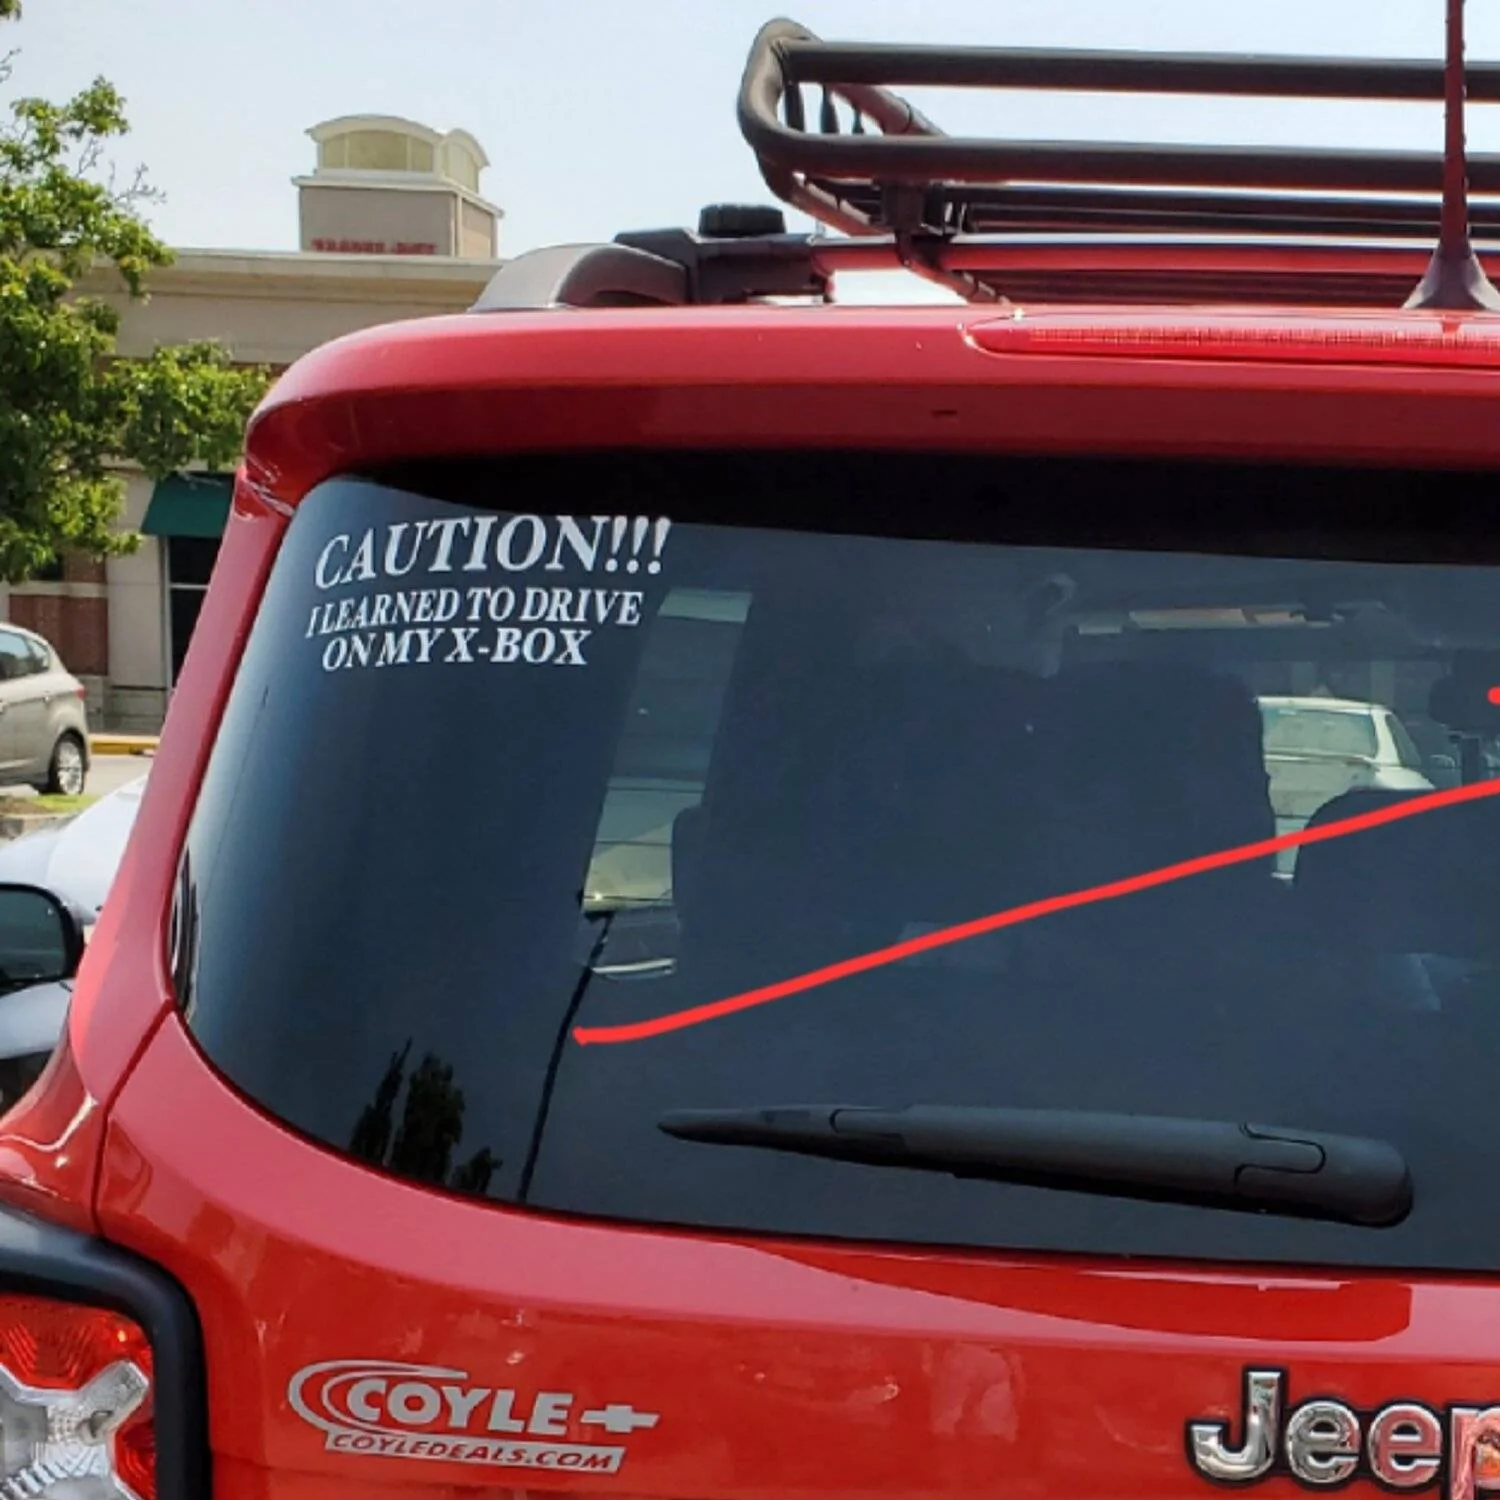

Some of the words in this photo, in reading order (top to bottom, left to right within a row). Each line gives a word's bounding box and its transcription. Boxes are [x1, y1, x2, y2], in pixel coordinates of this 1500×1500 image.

[315, 514, 672, 590] CAUTION!!!
[305, 606, 319, 639] I
[321, 589, 460, 634] LEARNED
[465, 587, 517, 623] TO
[519, 588, 643, 626] DRIVE
[322, 632, 379, 672] ON
[375, 629, 446, 668] MY
[444, 626, 592, 667] X-BOX
[345, 1379, 573, 1435] COYLE
[331, 1433, 615, 1470] COYLEDEALS.COM
